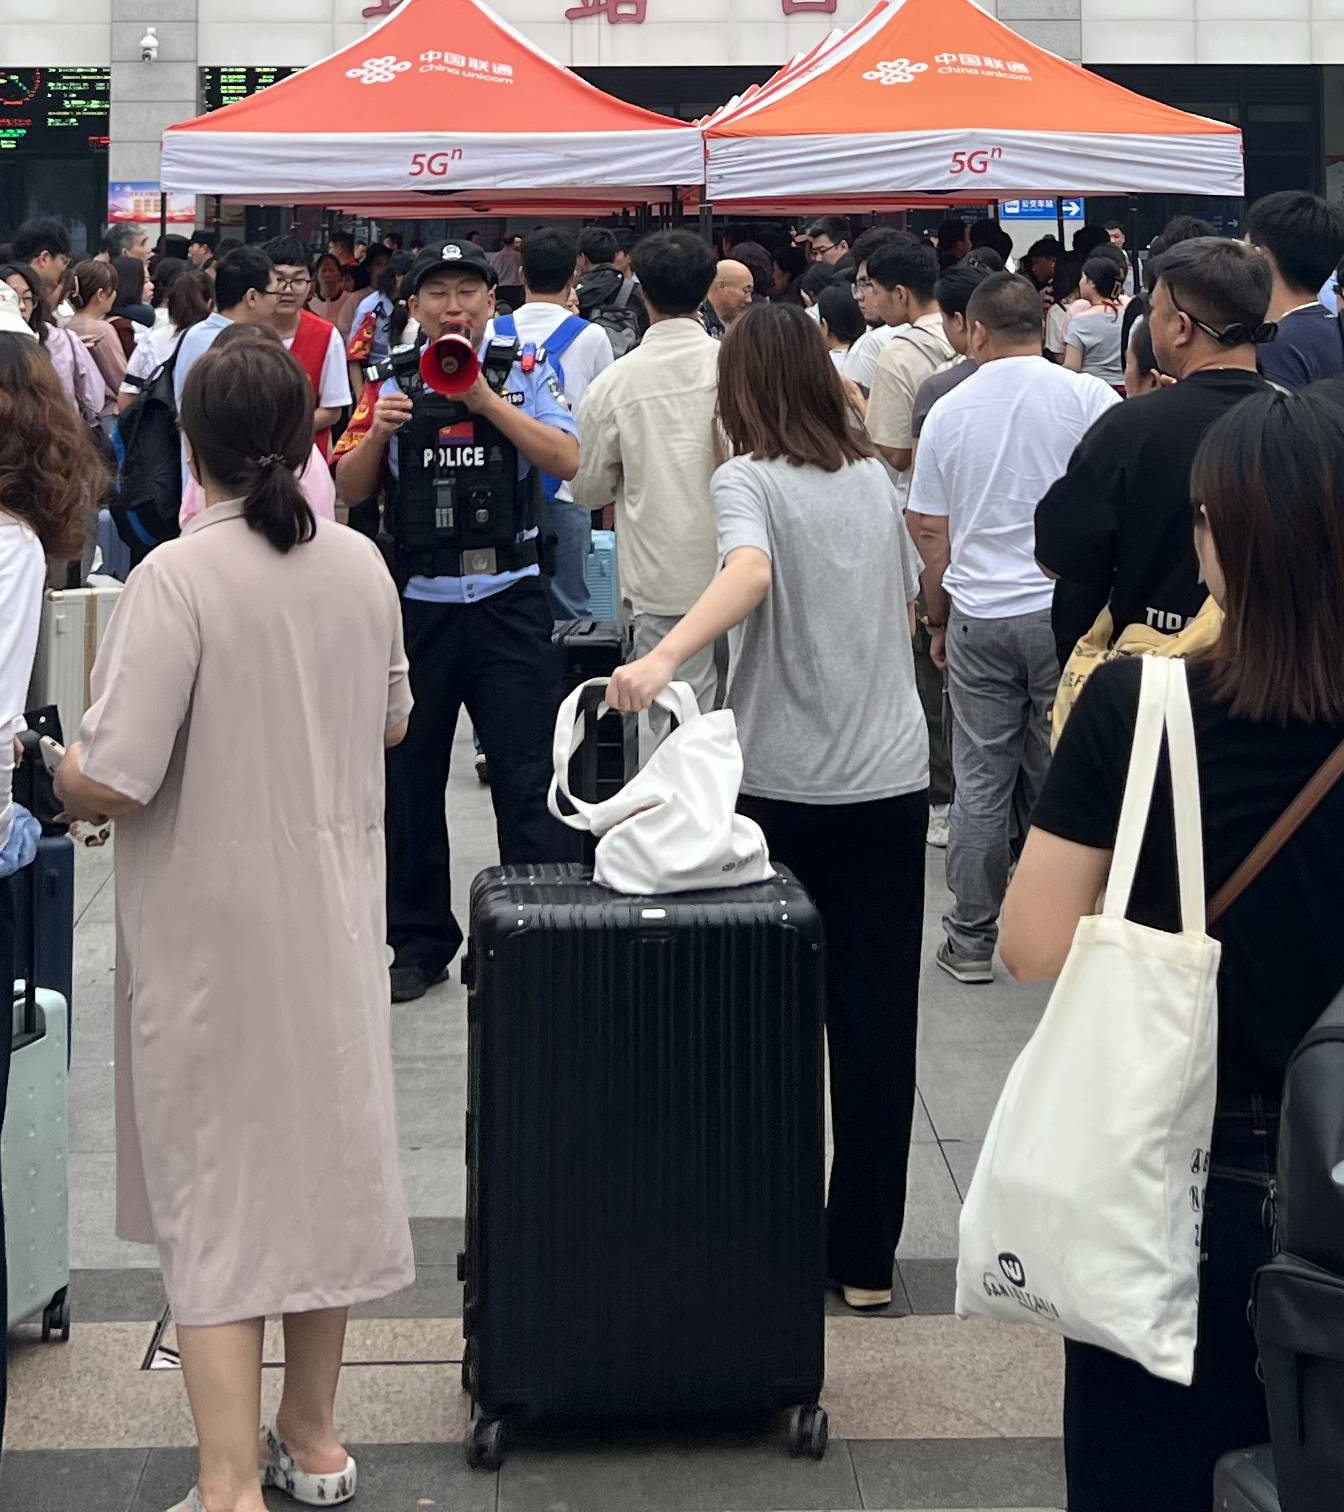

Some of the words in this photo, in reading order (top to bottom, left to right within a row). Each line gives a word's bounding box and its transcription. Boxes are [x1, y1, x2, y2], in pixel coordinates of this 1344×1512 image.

[419, 50, 514, 77] 中国联通
[419, 63, 460, 76] China
[462, 71, 514, 84] unicom
[934, 52, 1030, 74] 中国联通
[937, 65, 979, 76] China
[981, 70, 1033, 81] unicom
[423, 446, 485, 468] POLICE
